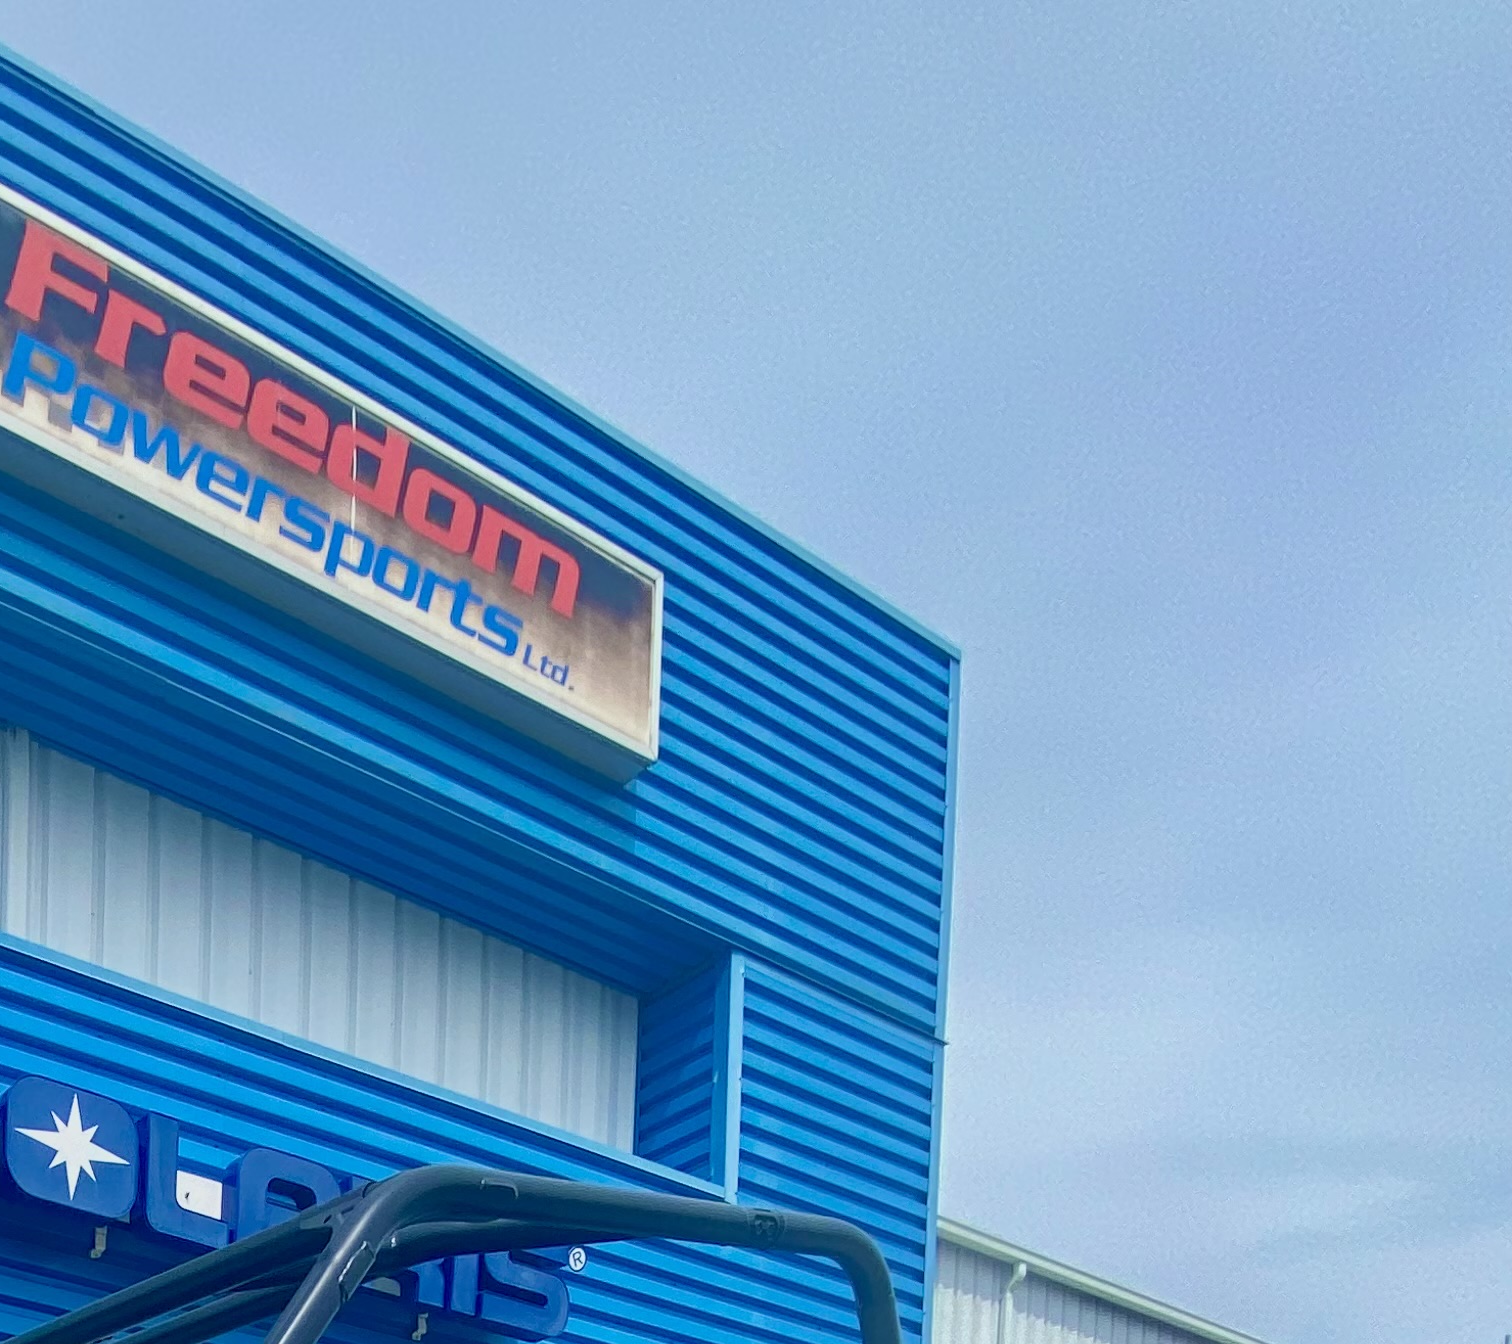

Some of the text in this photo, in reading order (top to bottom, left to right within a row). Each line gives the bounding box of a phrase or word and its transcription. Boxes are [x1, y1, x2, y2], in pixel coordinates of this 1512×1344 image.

[0, 331, 574, 691] Powersports Ltd.
[4, 220, 581, 618] Freedom
